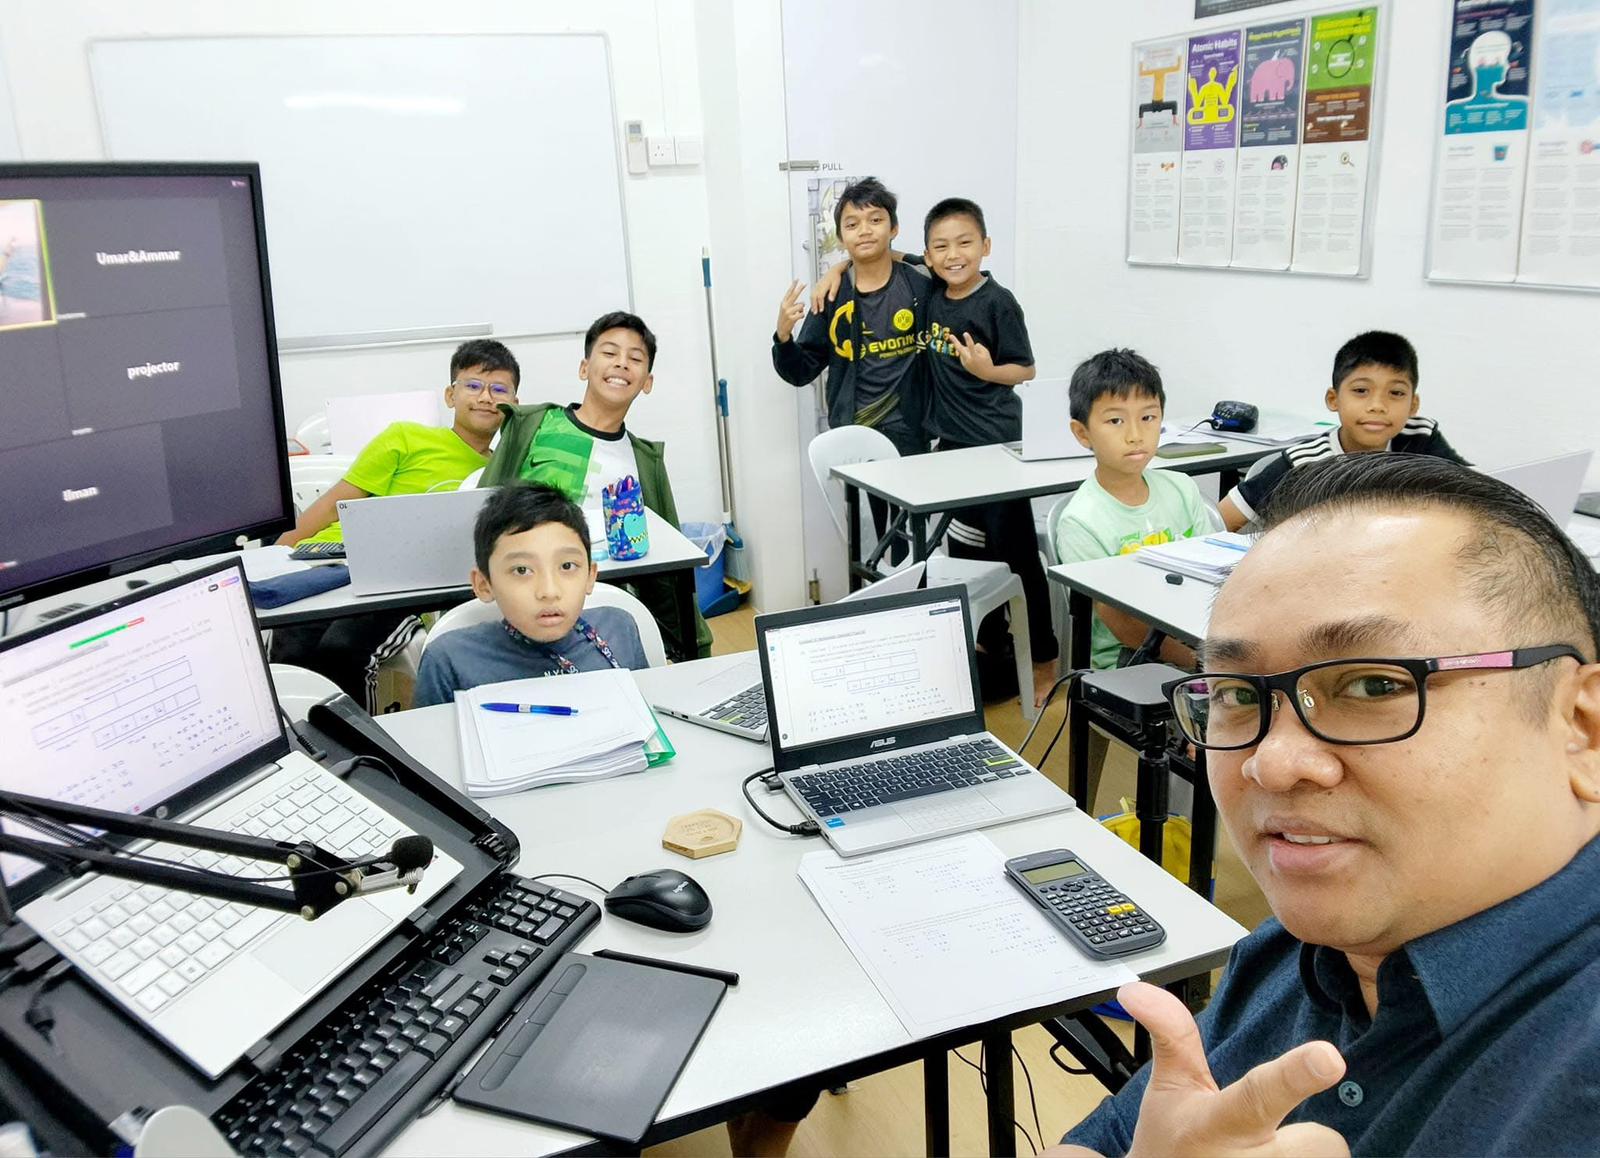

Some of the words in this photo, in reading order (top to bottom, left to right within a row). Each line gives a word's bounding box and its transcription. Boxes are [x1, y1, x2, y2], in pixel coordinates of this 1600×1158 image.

[822, 162, 844, 171] PULL
[96, 250, 181, 265] Umar&Ammar
[127, 361, 180, 380] projector
[869, 736, 897, 749] ASUS
